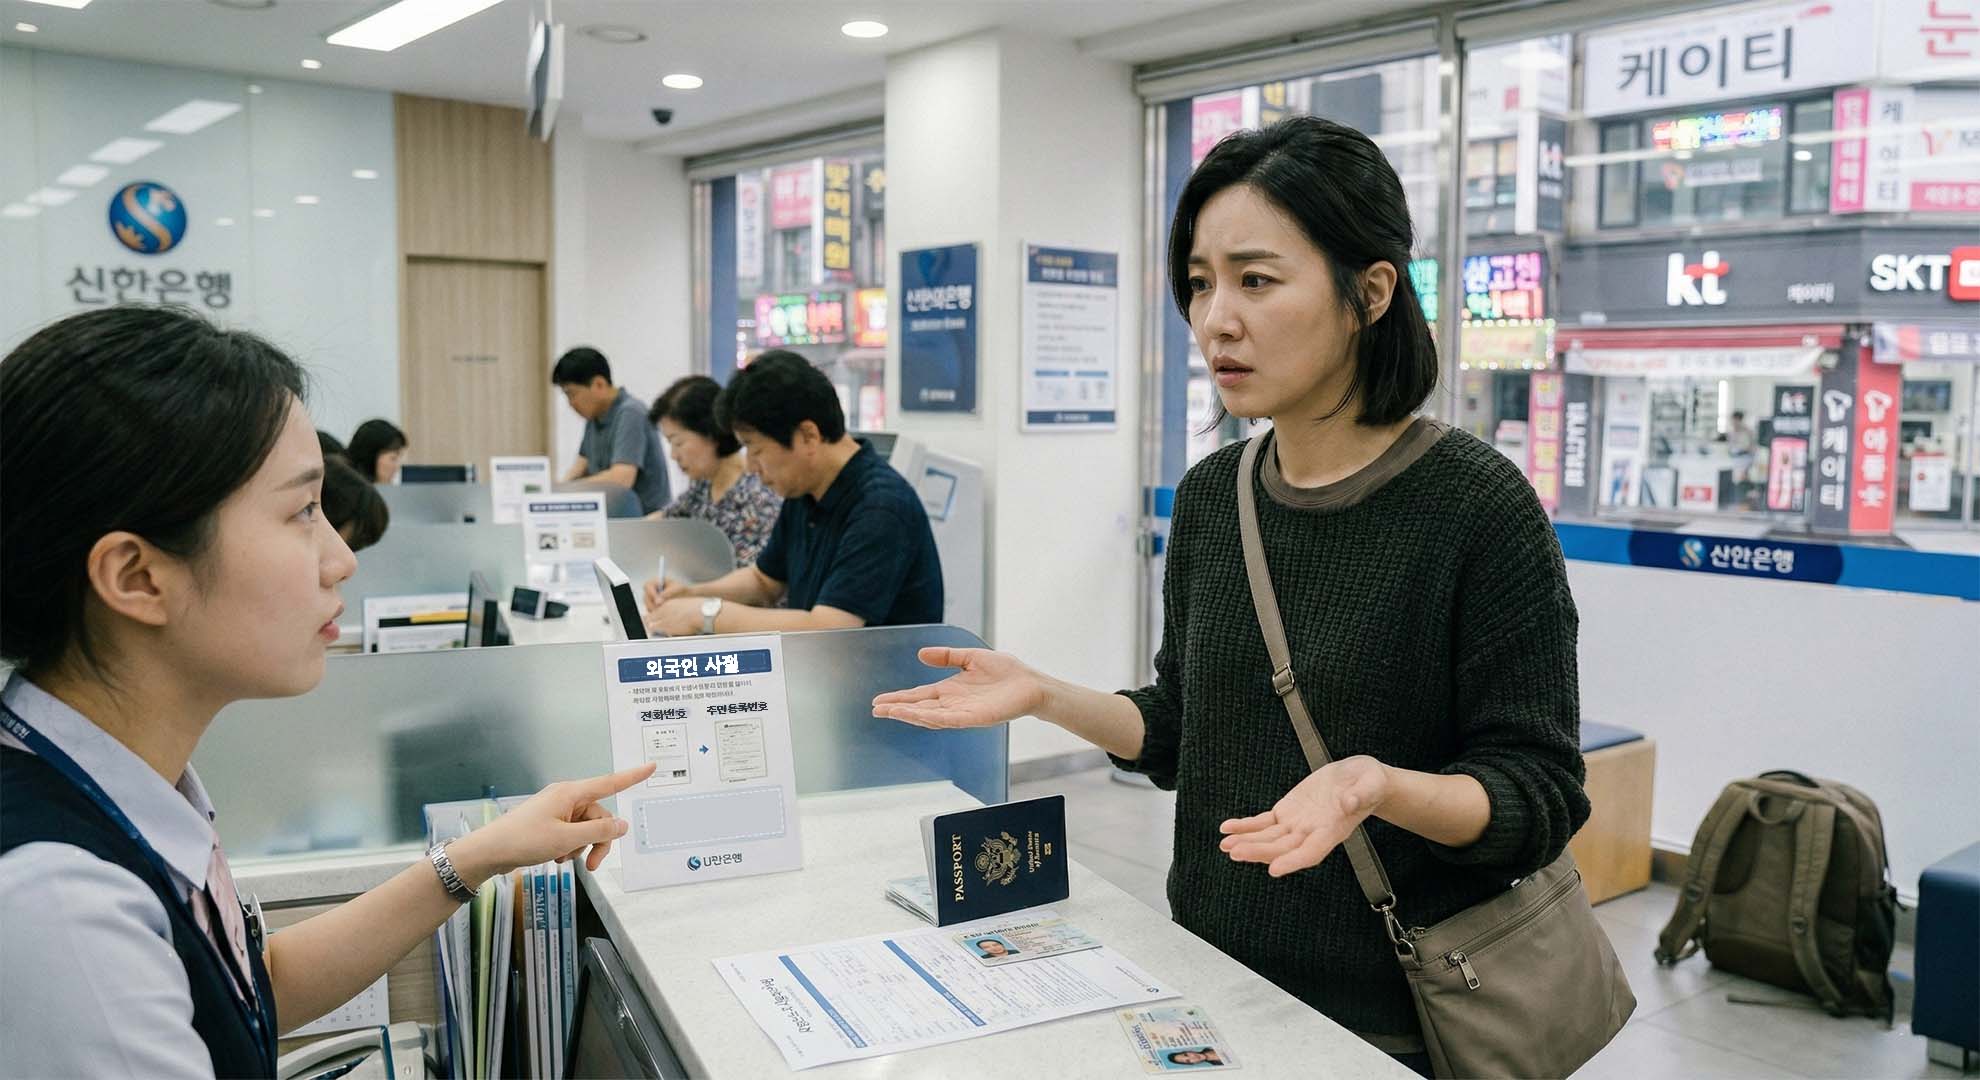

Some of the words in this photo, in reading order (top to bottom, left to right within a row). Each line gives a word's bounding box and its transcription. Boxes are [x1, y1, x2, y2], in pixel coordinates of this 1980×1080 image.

[1619, 25, 1794, 96] 케이티
[66, 265, 232, 308] 신한은행
[1667, 250, 1728, 306] kt
[1869, 253, 1951, 291] SKT
[1820, 426, 1849, 511] 케이티
[646, 656, 698, 679] 외국인
[641, 708, 688, 722] 전화번호
[951, 833, 965, 902] PASSPORT
